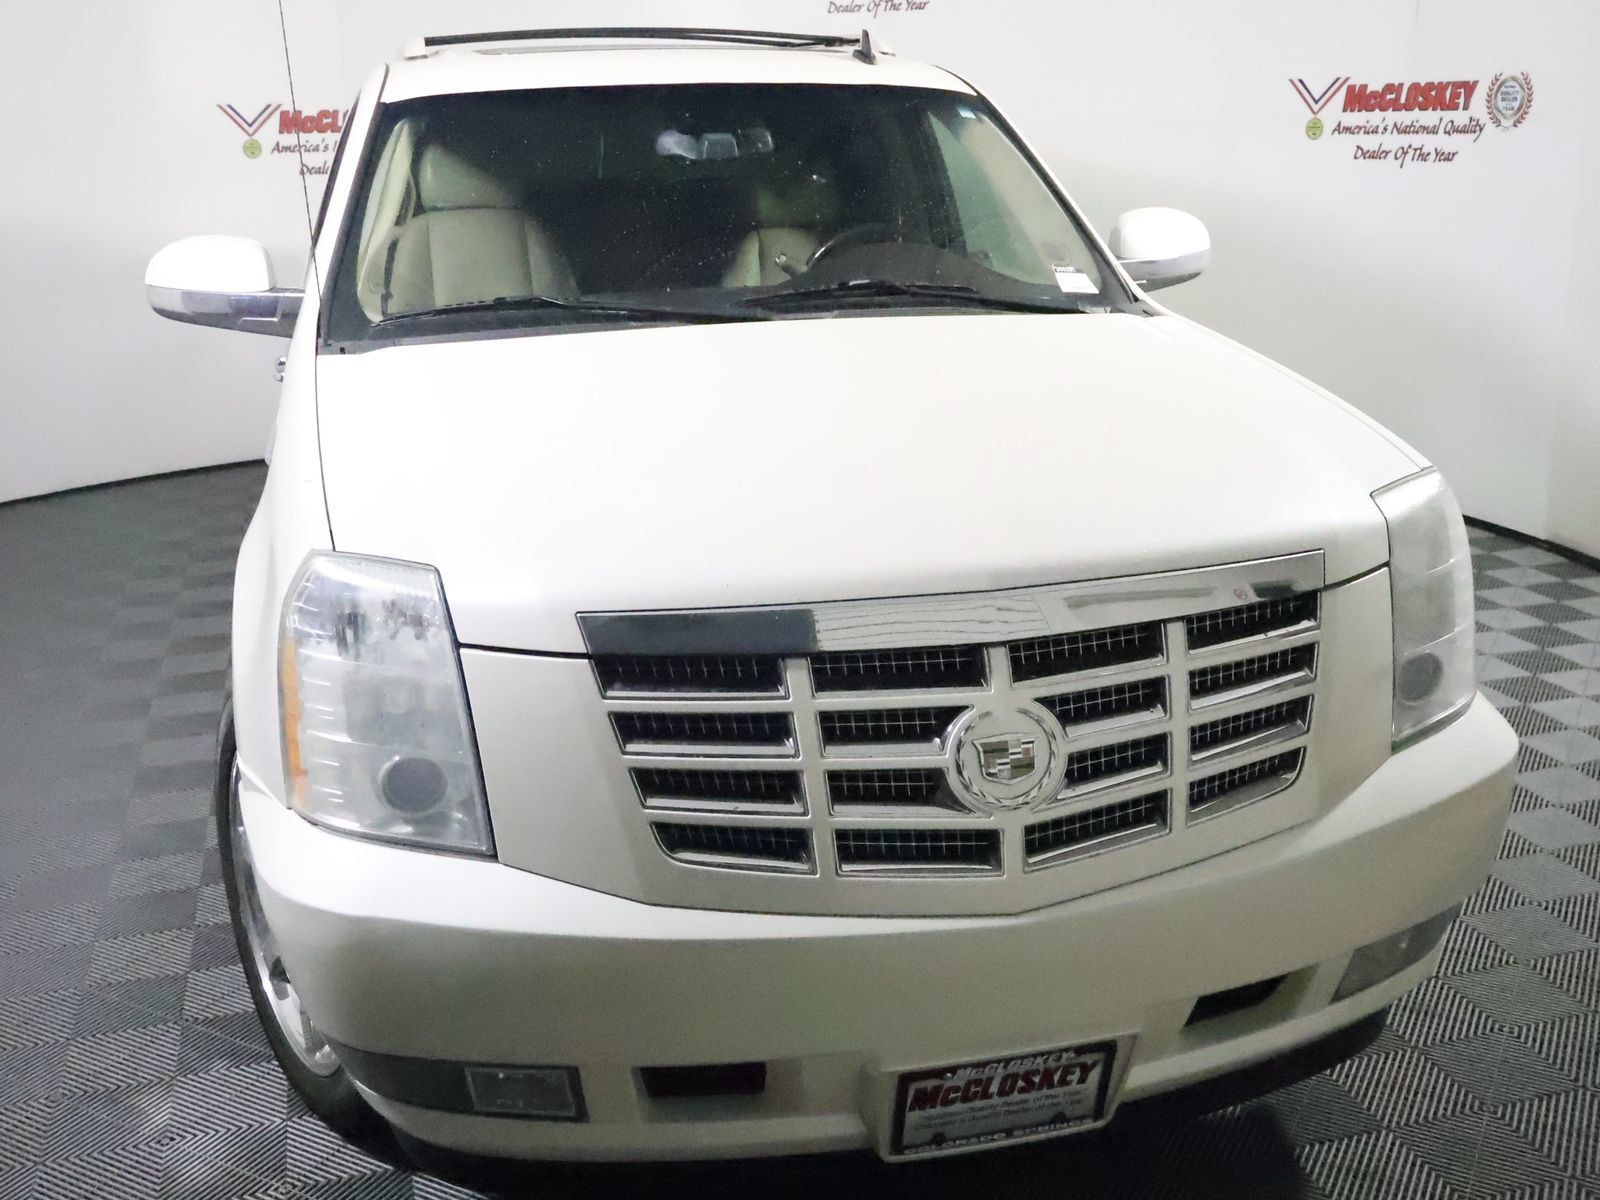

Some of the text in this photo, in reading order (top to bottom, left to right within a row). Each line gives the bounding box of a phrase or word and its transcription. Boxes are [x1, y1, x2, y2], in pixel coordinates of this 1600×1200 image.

[827, 0, 930, 19] Dealer Of The Year
[1342, 81, 1479, 112] McCLOSKEY
[279, 109, 349, 134] McCL
[1331, 117, 1389, 136] America's
[1391, 117, 1441, 136] National
[1443, 116, 1486, 142] Quality
[271, 138, 330, 154] America's
[1353, 142, 1459, 168] Dealer Of The Year
[907, 1060, 1099, 1112] McCLOSKEY
